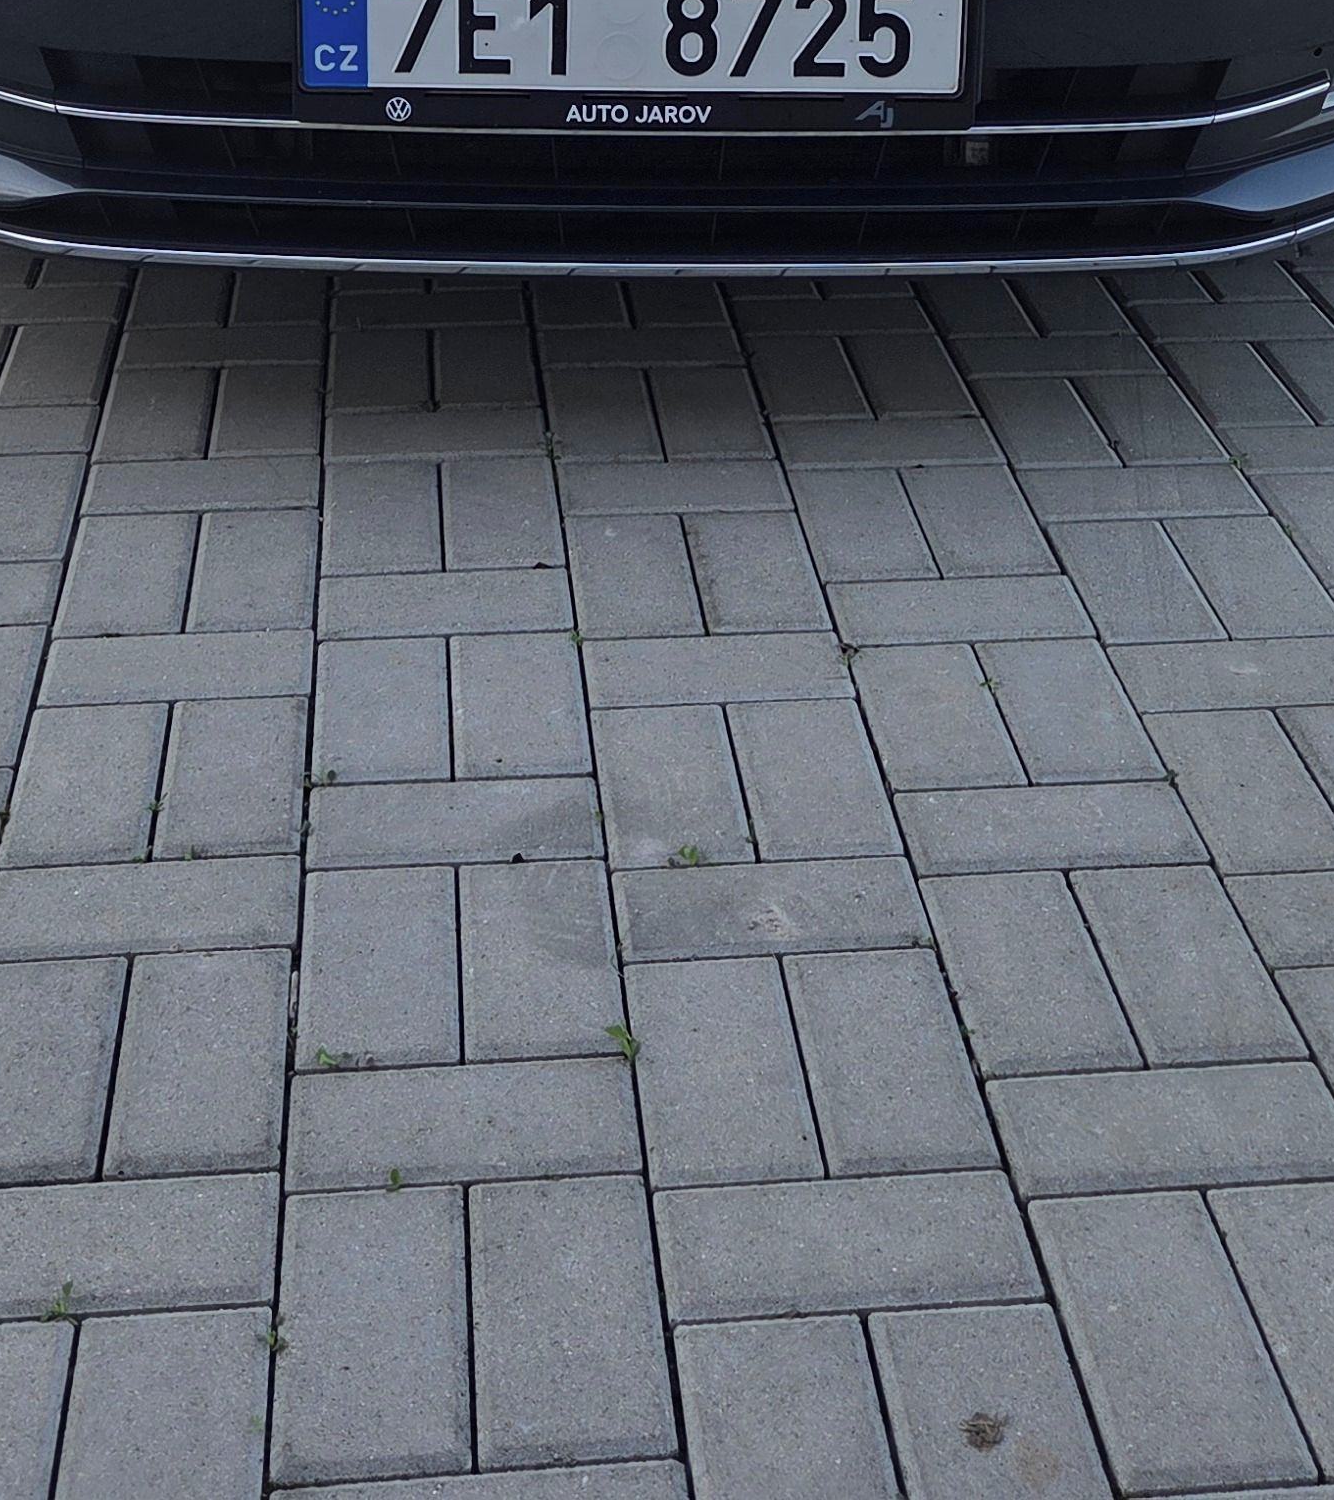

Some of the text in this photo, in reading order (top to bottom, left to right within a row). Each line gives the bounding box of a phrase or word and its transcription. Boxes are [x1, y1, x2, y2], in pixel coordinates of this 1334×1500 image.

[314, 45, 359, 72] CZ
[386, 97, 411, 121] VW
[566, 105, 712, 124] AUTO JAROV
